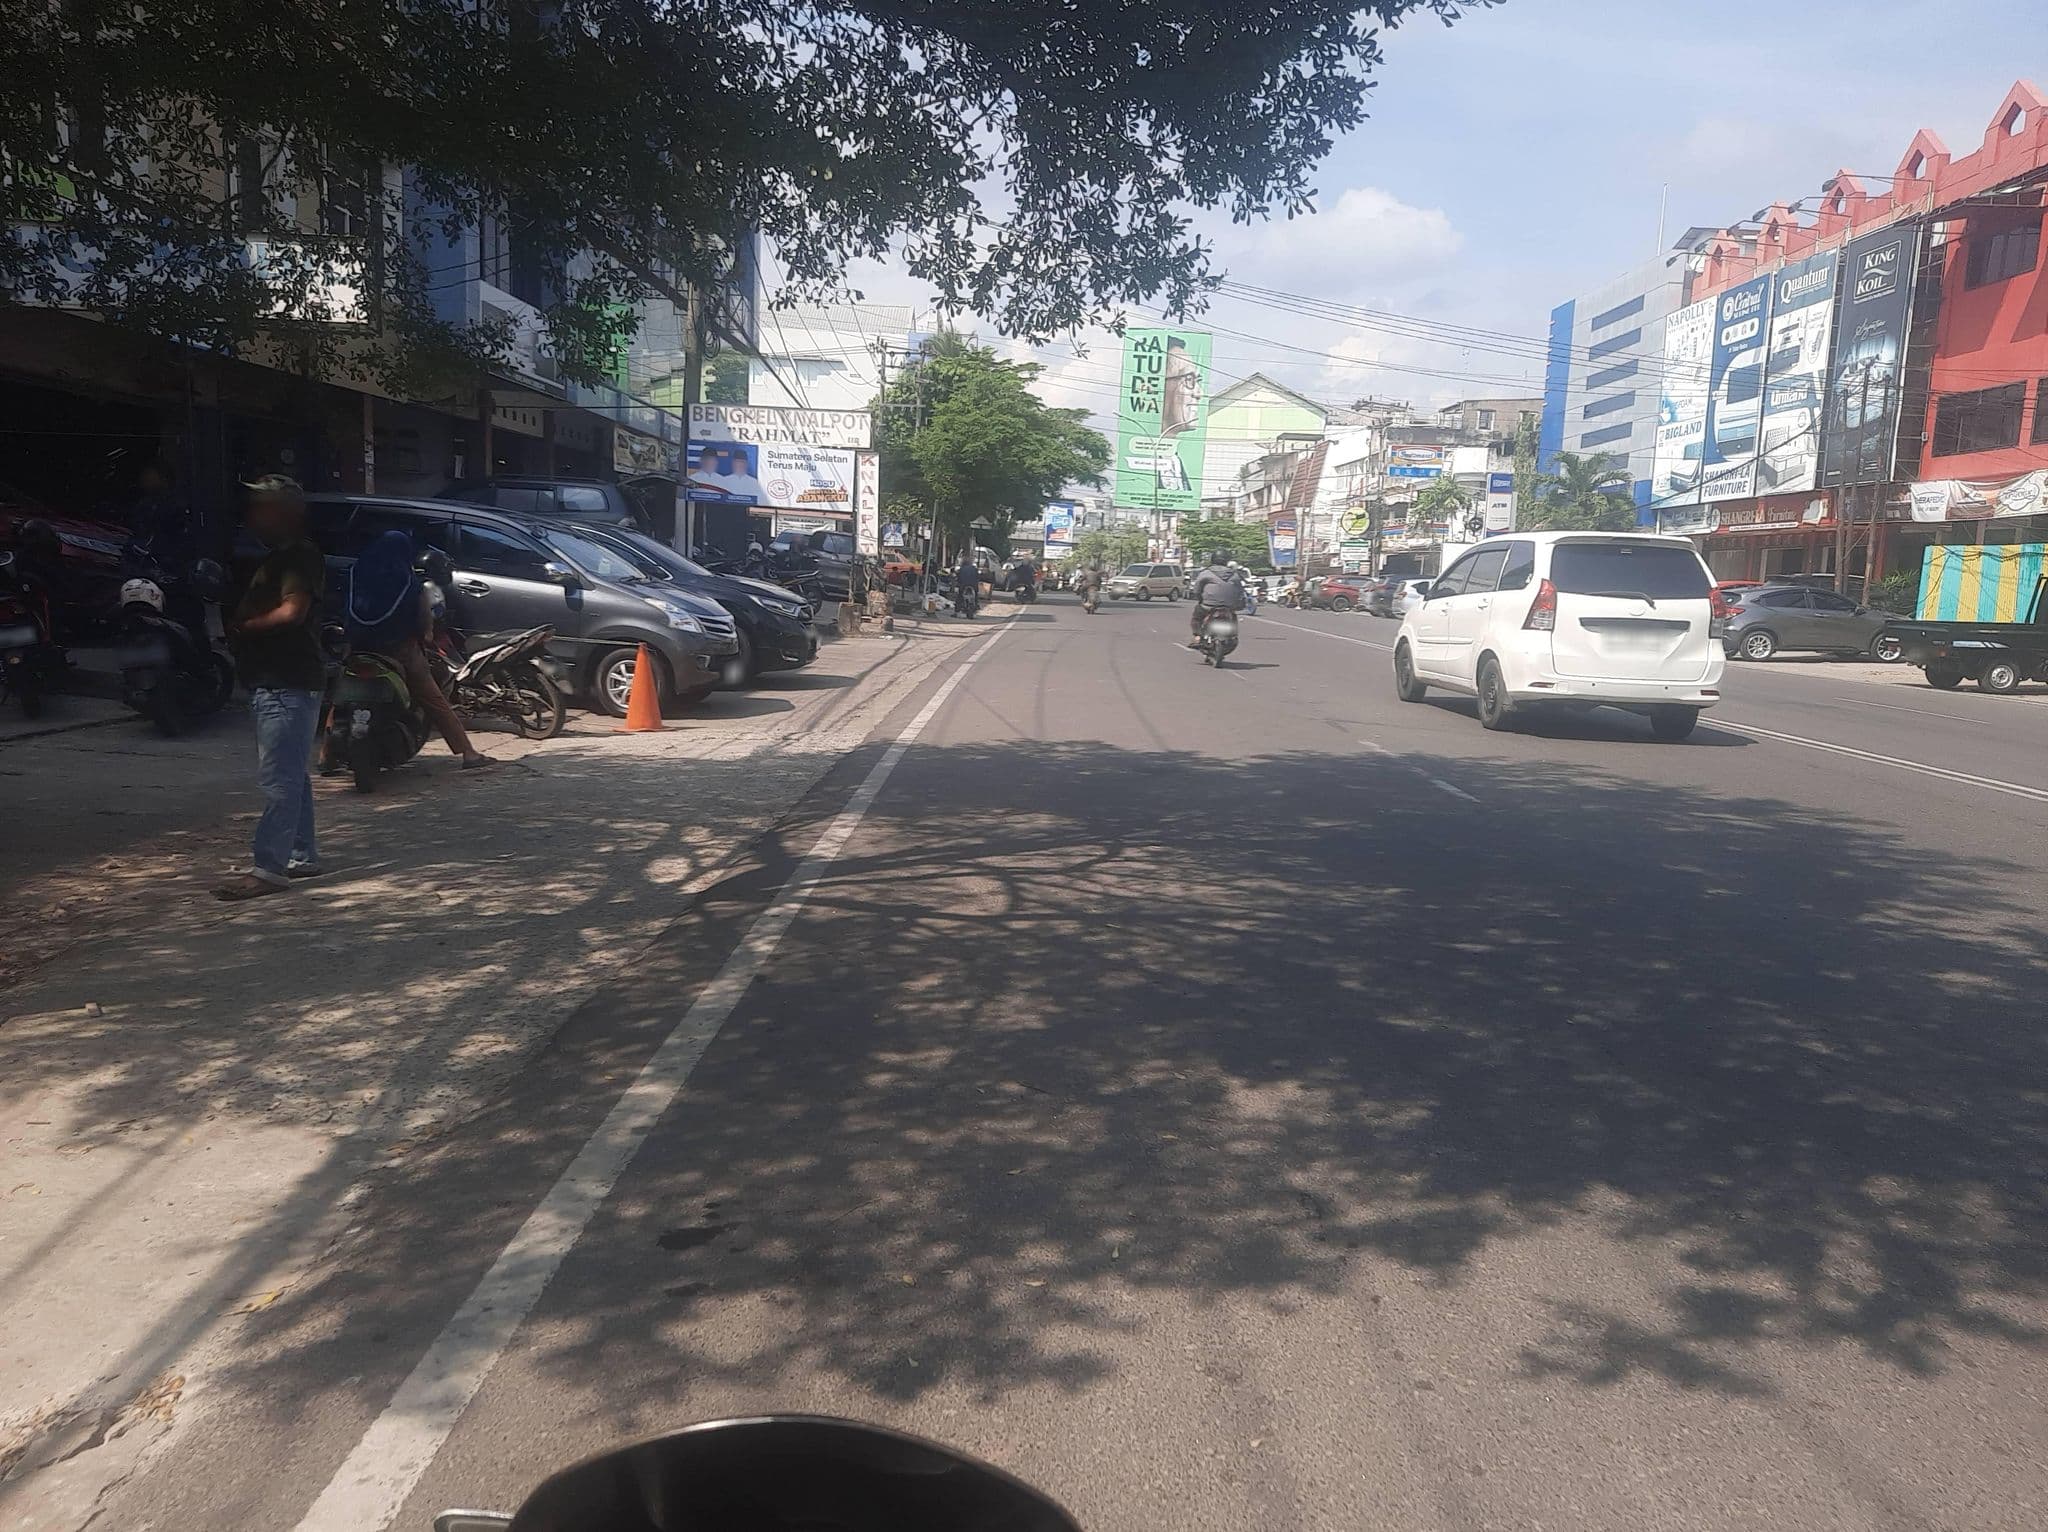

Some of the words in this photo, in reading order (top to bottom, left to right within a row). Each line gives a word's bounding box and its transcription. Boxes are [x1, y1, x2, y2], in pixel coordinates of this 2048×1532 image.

[1864, 247, 1897, 270] KING
[1780, 267, 1829, 304] Quantum
[1856, 275, 1887, 296] KOIL
[1667, 302, 1706, 329] NAPOLLY
[1134, 336, 1162, 354] RA
[1133, 354, 1162, 375] TU
[1131, 375, 1160, 395] DE
[1130, 396, 1160, 414] WA
[693, 405, 778, 427] BENGKEL
[1665, 421, 1702, 440] BIGLAND
[768, 450, 812, 462] Sumatera
[814, 452, 848, 464] Selatan
[768, 461, 793, 471] Terus
[795, 462, 817, 473] Maju
[1703, 465, 1751, 482] SHANGRI-LA
[1703, 481, 1749, 498] FURNITURE
[1720, 510, 1765, 526] SHANGRI-LA
